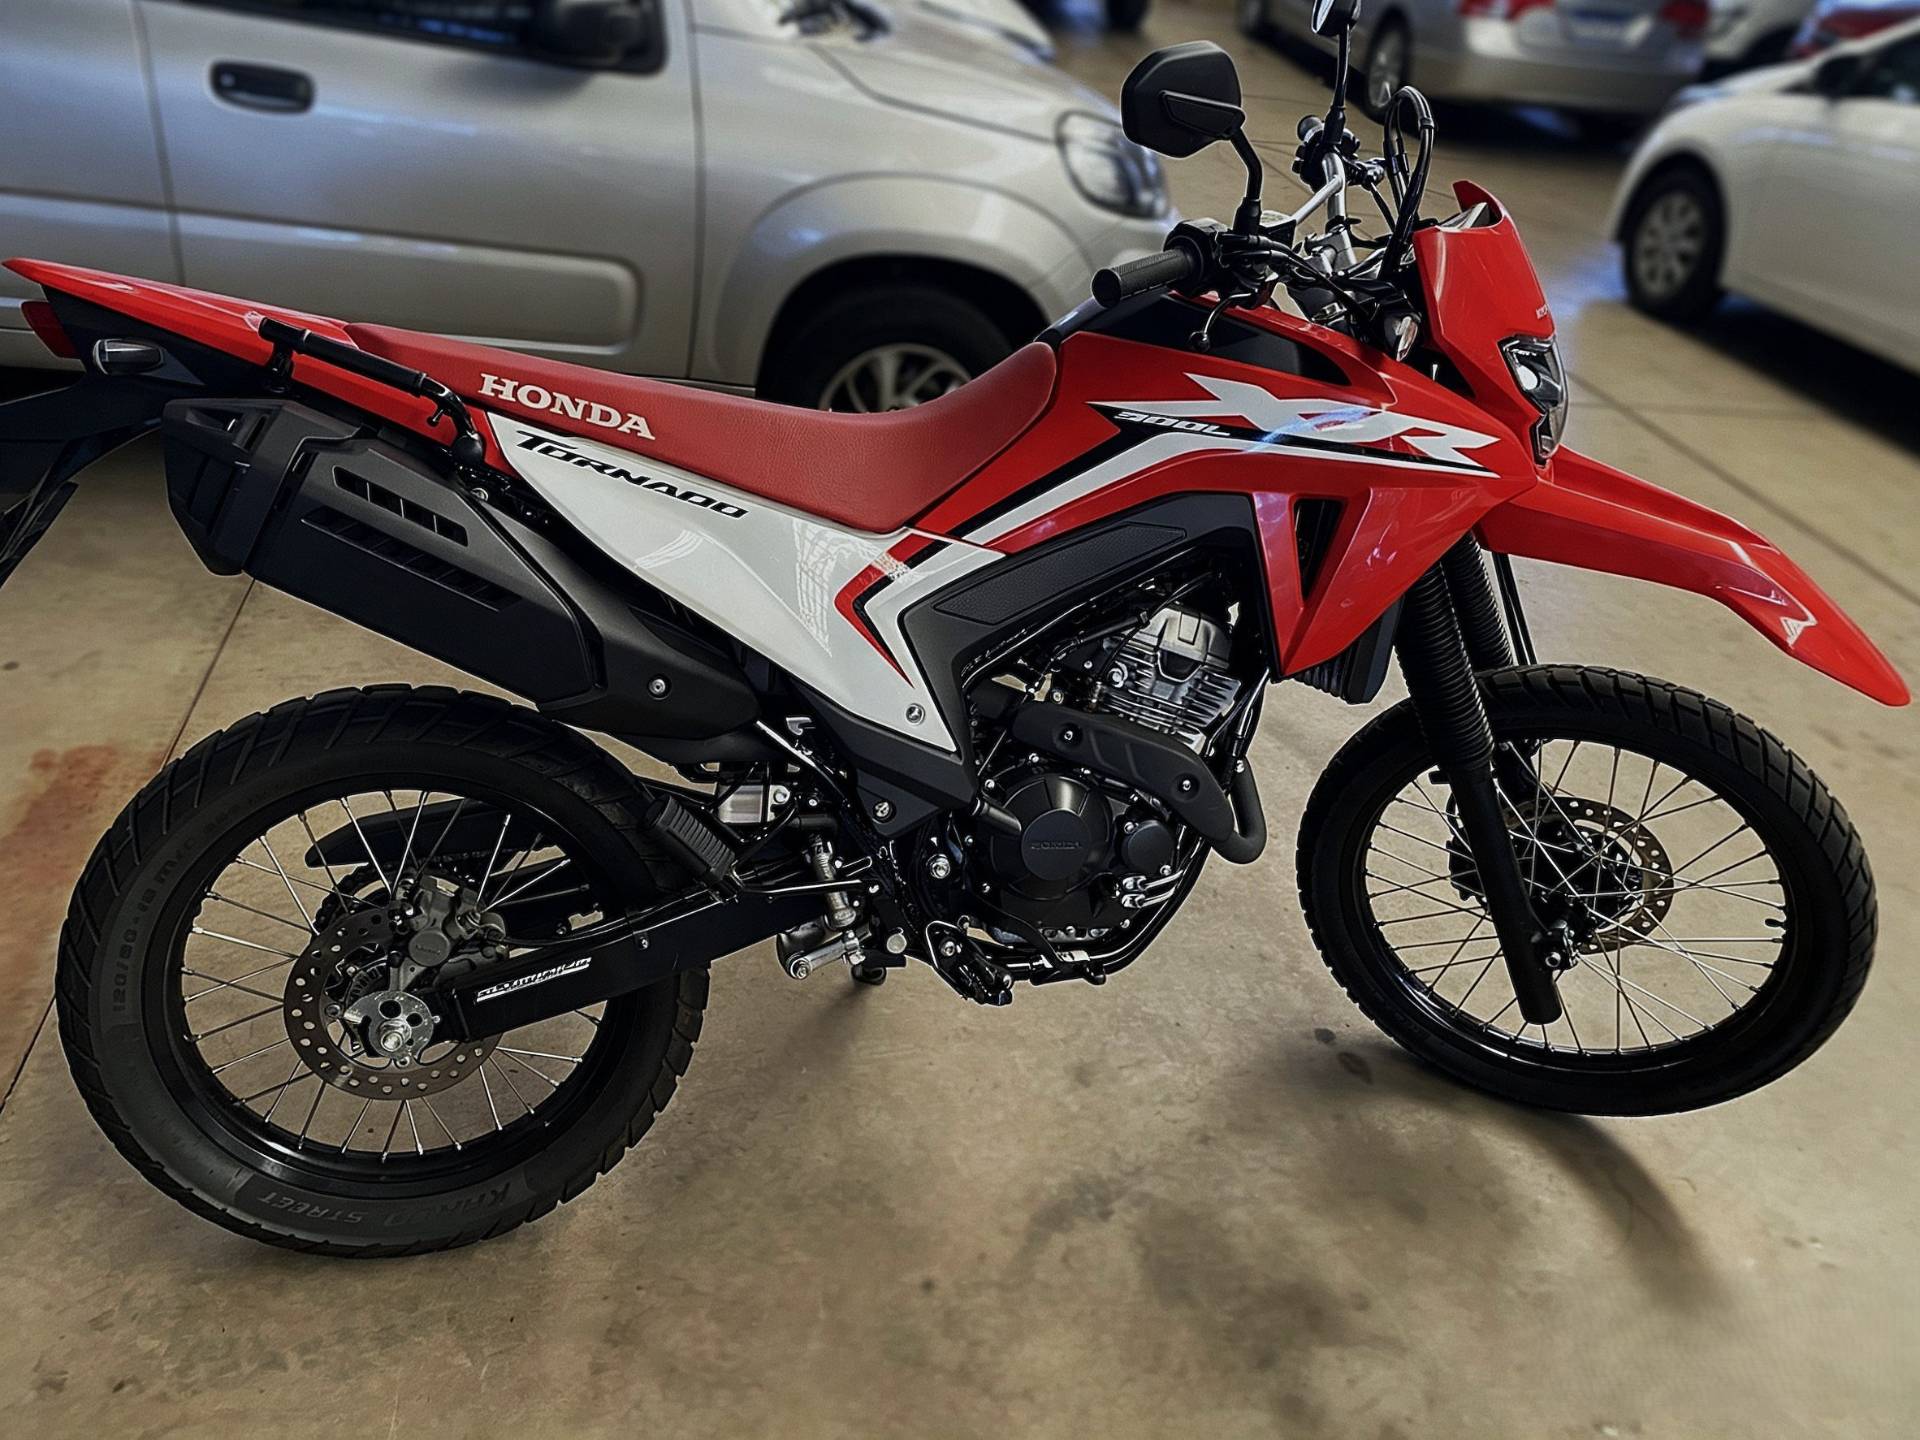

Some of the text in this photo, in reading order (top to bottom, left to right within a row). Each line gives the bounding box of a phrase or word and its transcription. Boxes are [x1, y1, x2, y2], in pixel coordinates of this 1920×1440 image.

[478, 373, 656, 441] HONDA
[1114, 411, 1231, 436] 300L
[516, 430, 749, 519] TORNADO
